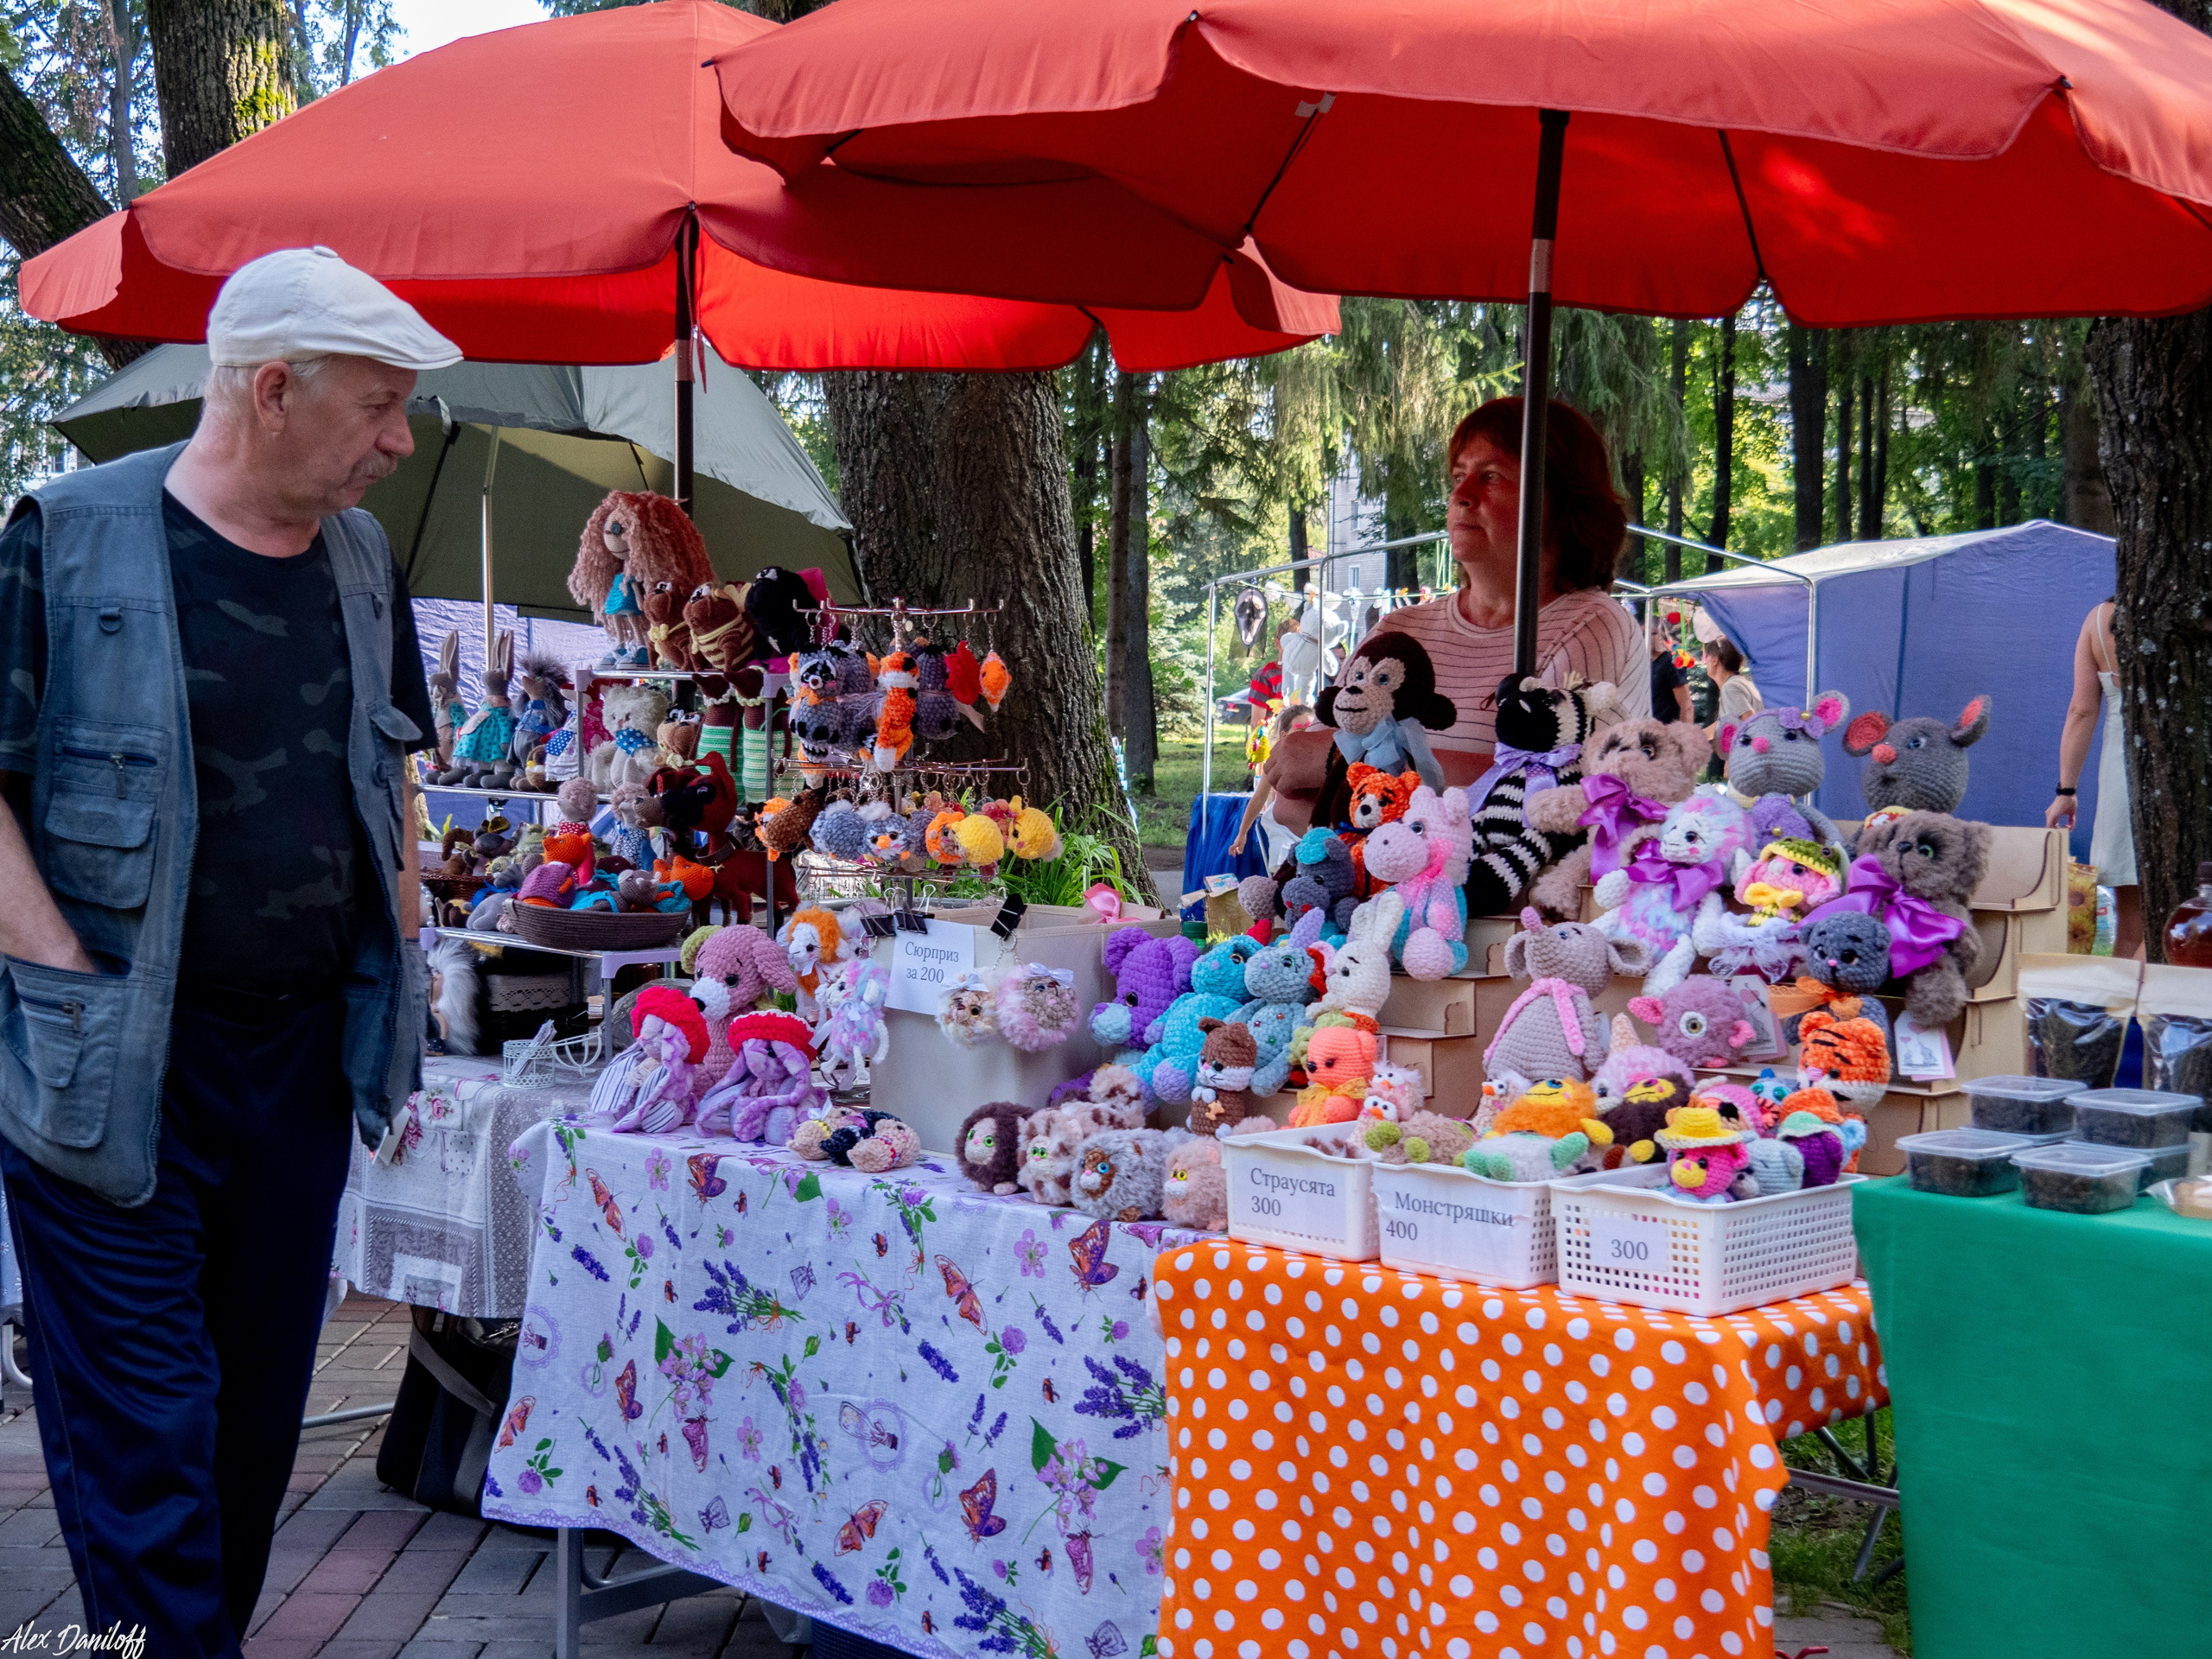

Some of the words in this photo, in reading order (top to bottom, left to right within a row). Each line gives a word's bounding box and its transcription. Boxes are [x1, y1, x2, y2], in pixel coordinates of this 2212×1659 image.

[905, 941, 959, 963] Сюрприз
[906, 968, 918, 980] за
[920, 967, 944, 983] 200
[1250, 1167, 1336, 1198] Страусята
[1251, 1196, 1281, 1217] 300
[1394, 1191, 1514, 1228] Монстряшки
[1385, 1220, 1418, 1241] 400
[1610, 1239, 1649, 1261] 300
